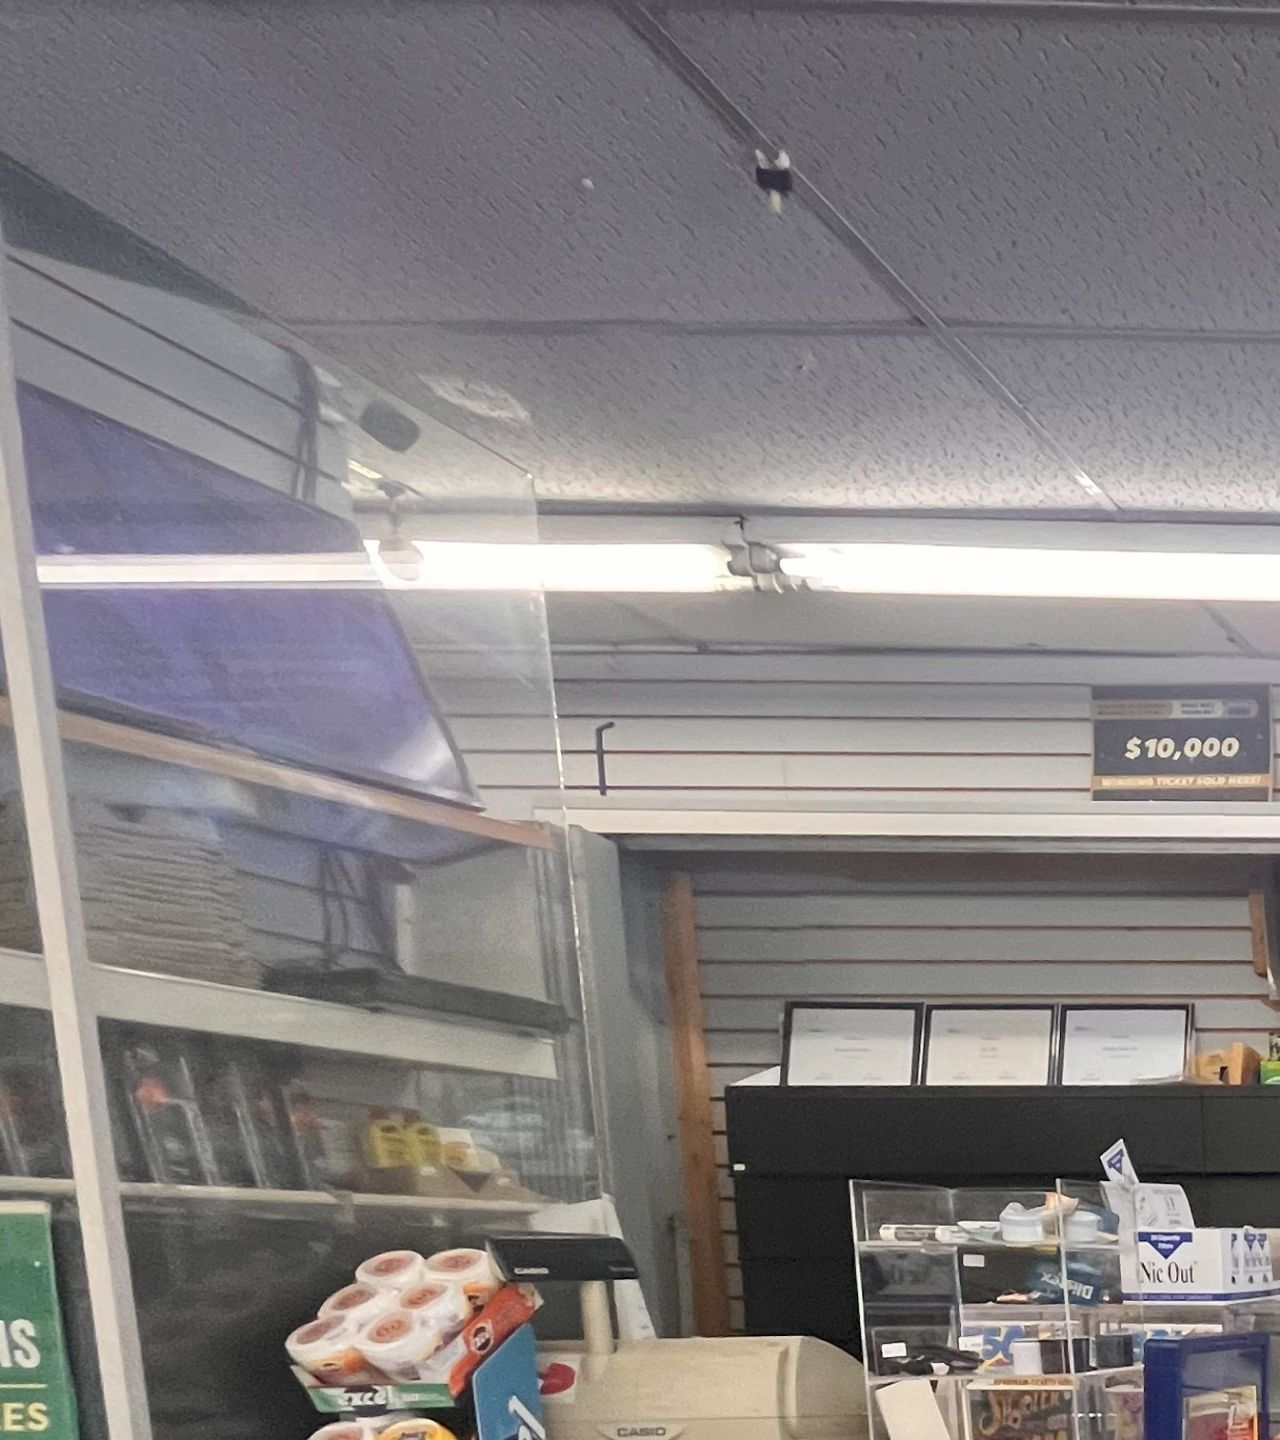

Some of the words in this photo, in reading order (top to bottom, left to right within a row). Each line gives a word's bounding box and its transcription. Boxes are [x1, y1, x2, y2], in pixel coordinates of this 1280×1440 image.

[1124, 736, 1240, 760] $10,000
[1140, 1261, 1164, 1284] Nic
[1167, 1261, 1195, 1284] Out
[0, 1402, 49, 1432] ES
[616, 1426, 667, 1439] CASIO
